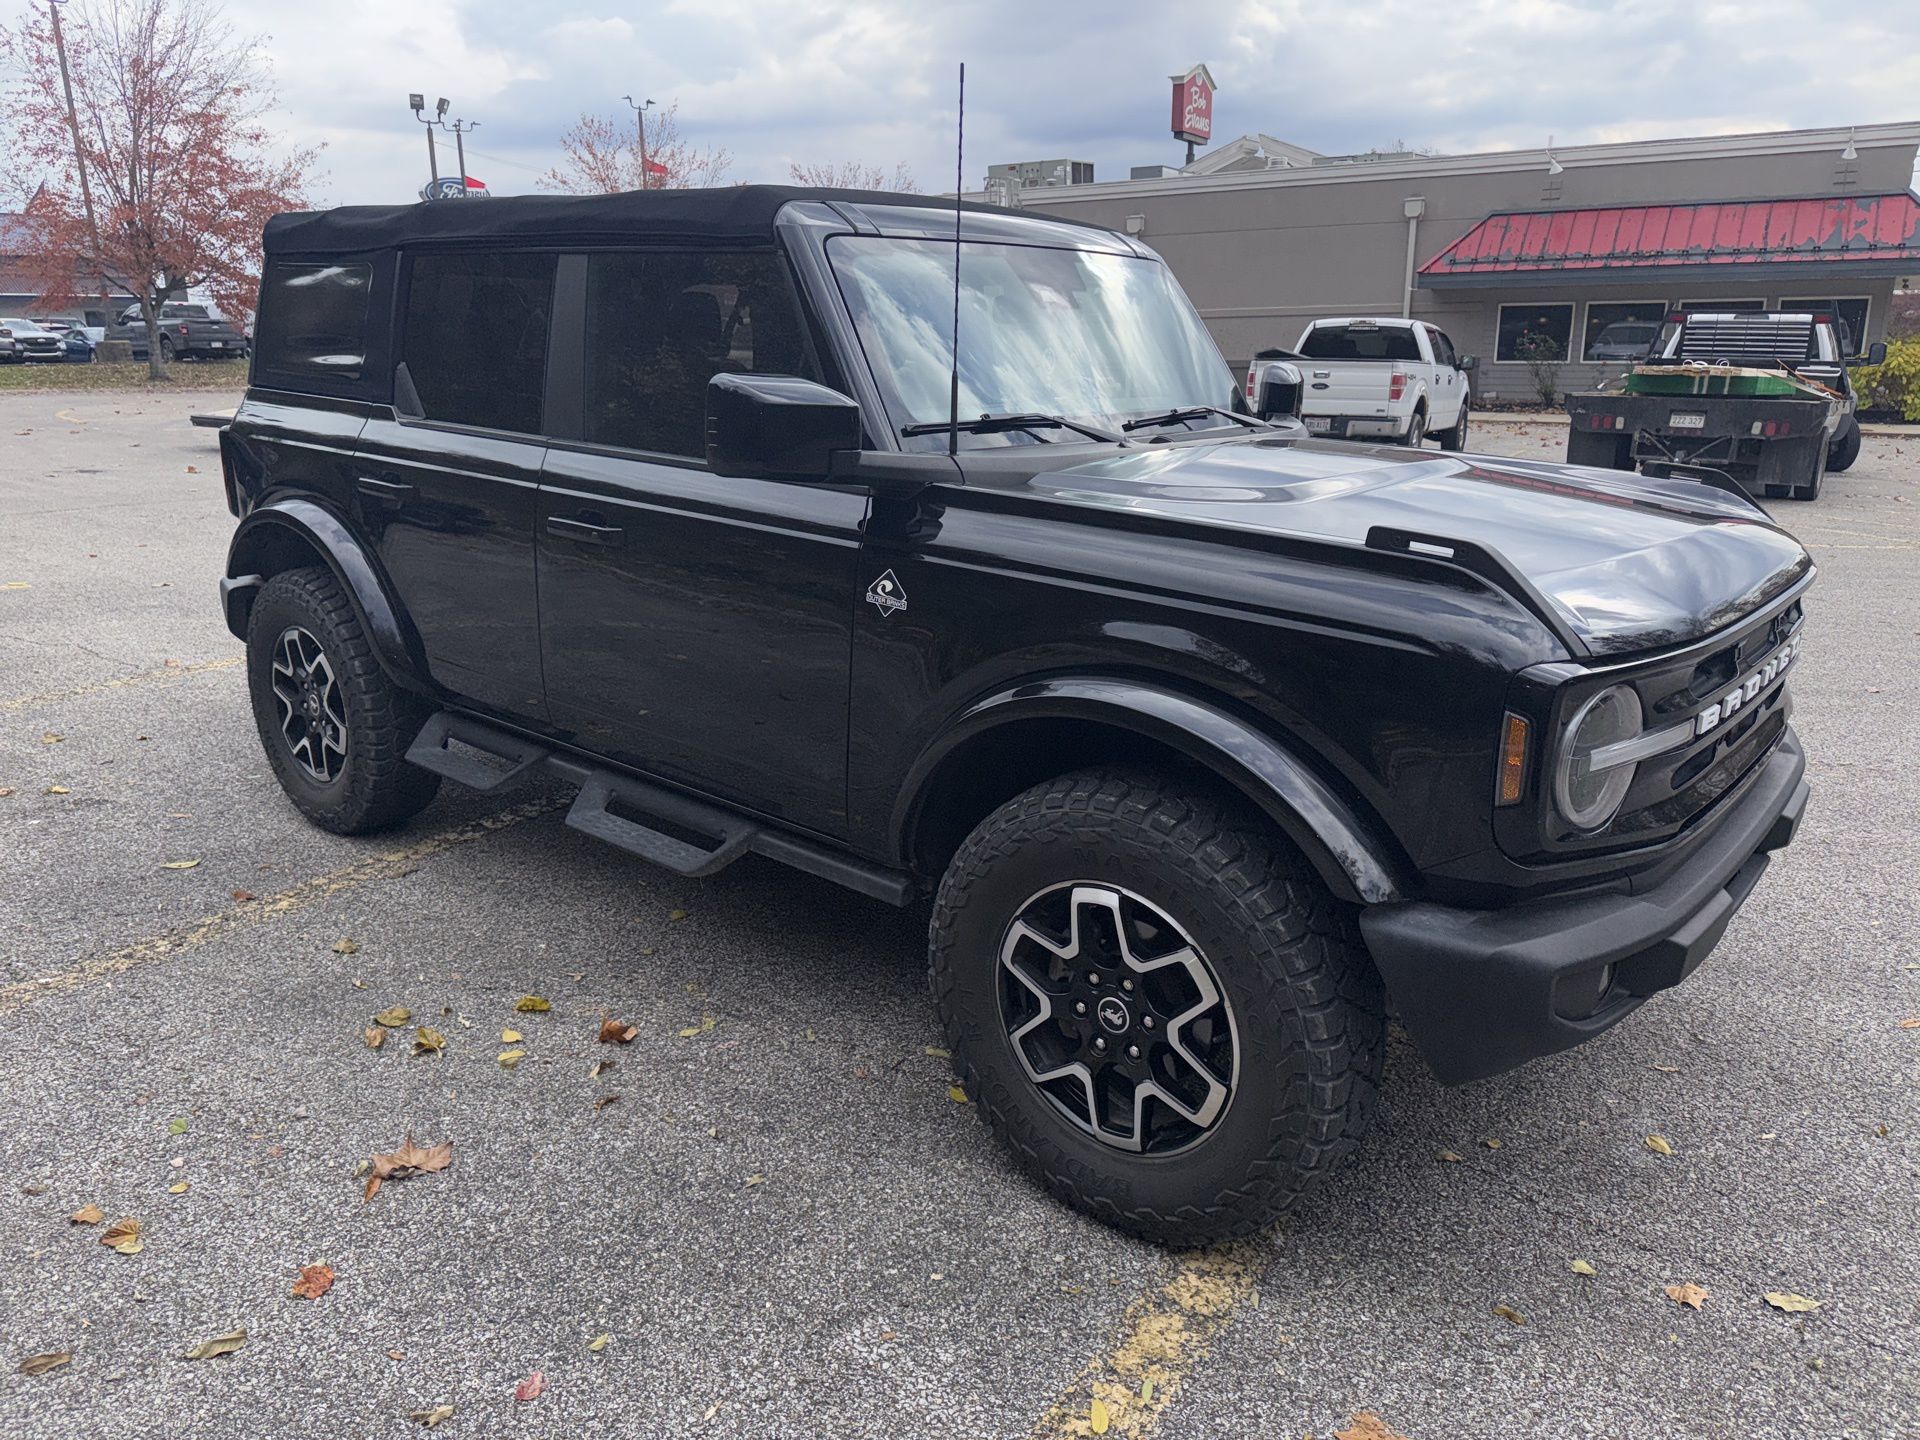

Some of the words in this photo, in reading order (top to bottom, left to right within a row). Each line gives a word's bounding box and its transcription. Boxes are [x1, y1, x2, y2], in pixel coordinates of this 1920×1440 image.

[1190, 86, 1207, 110] Bob
[1184, 106, 1210, 132] Evans
[1696, 632, 1802, 735] BRONCO
